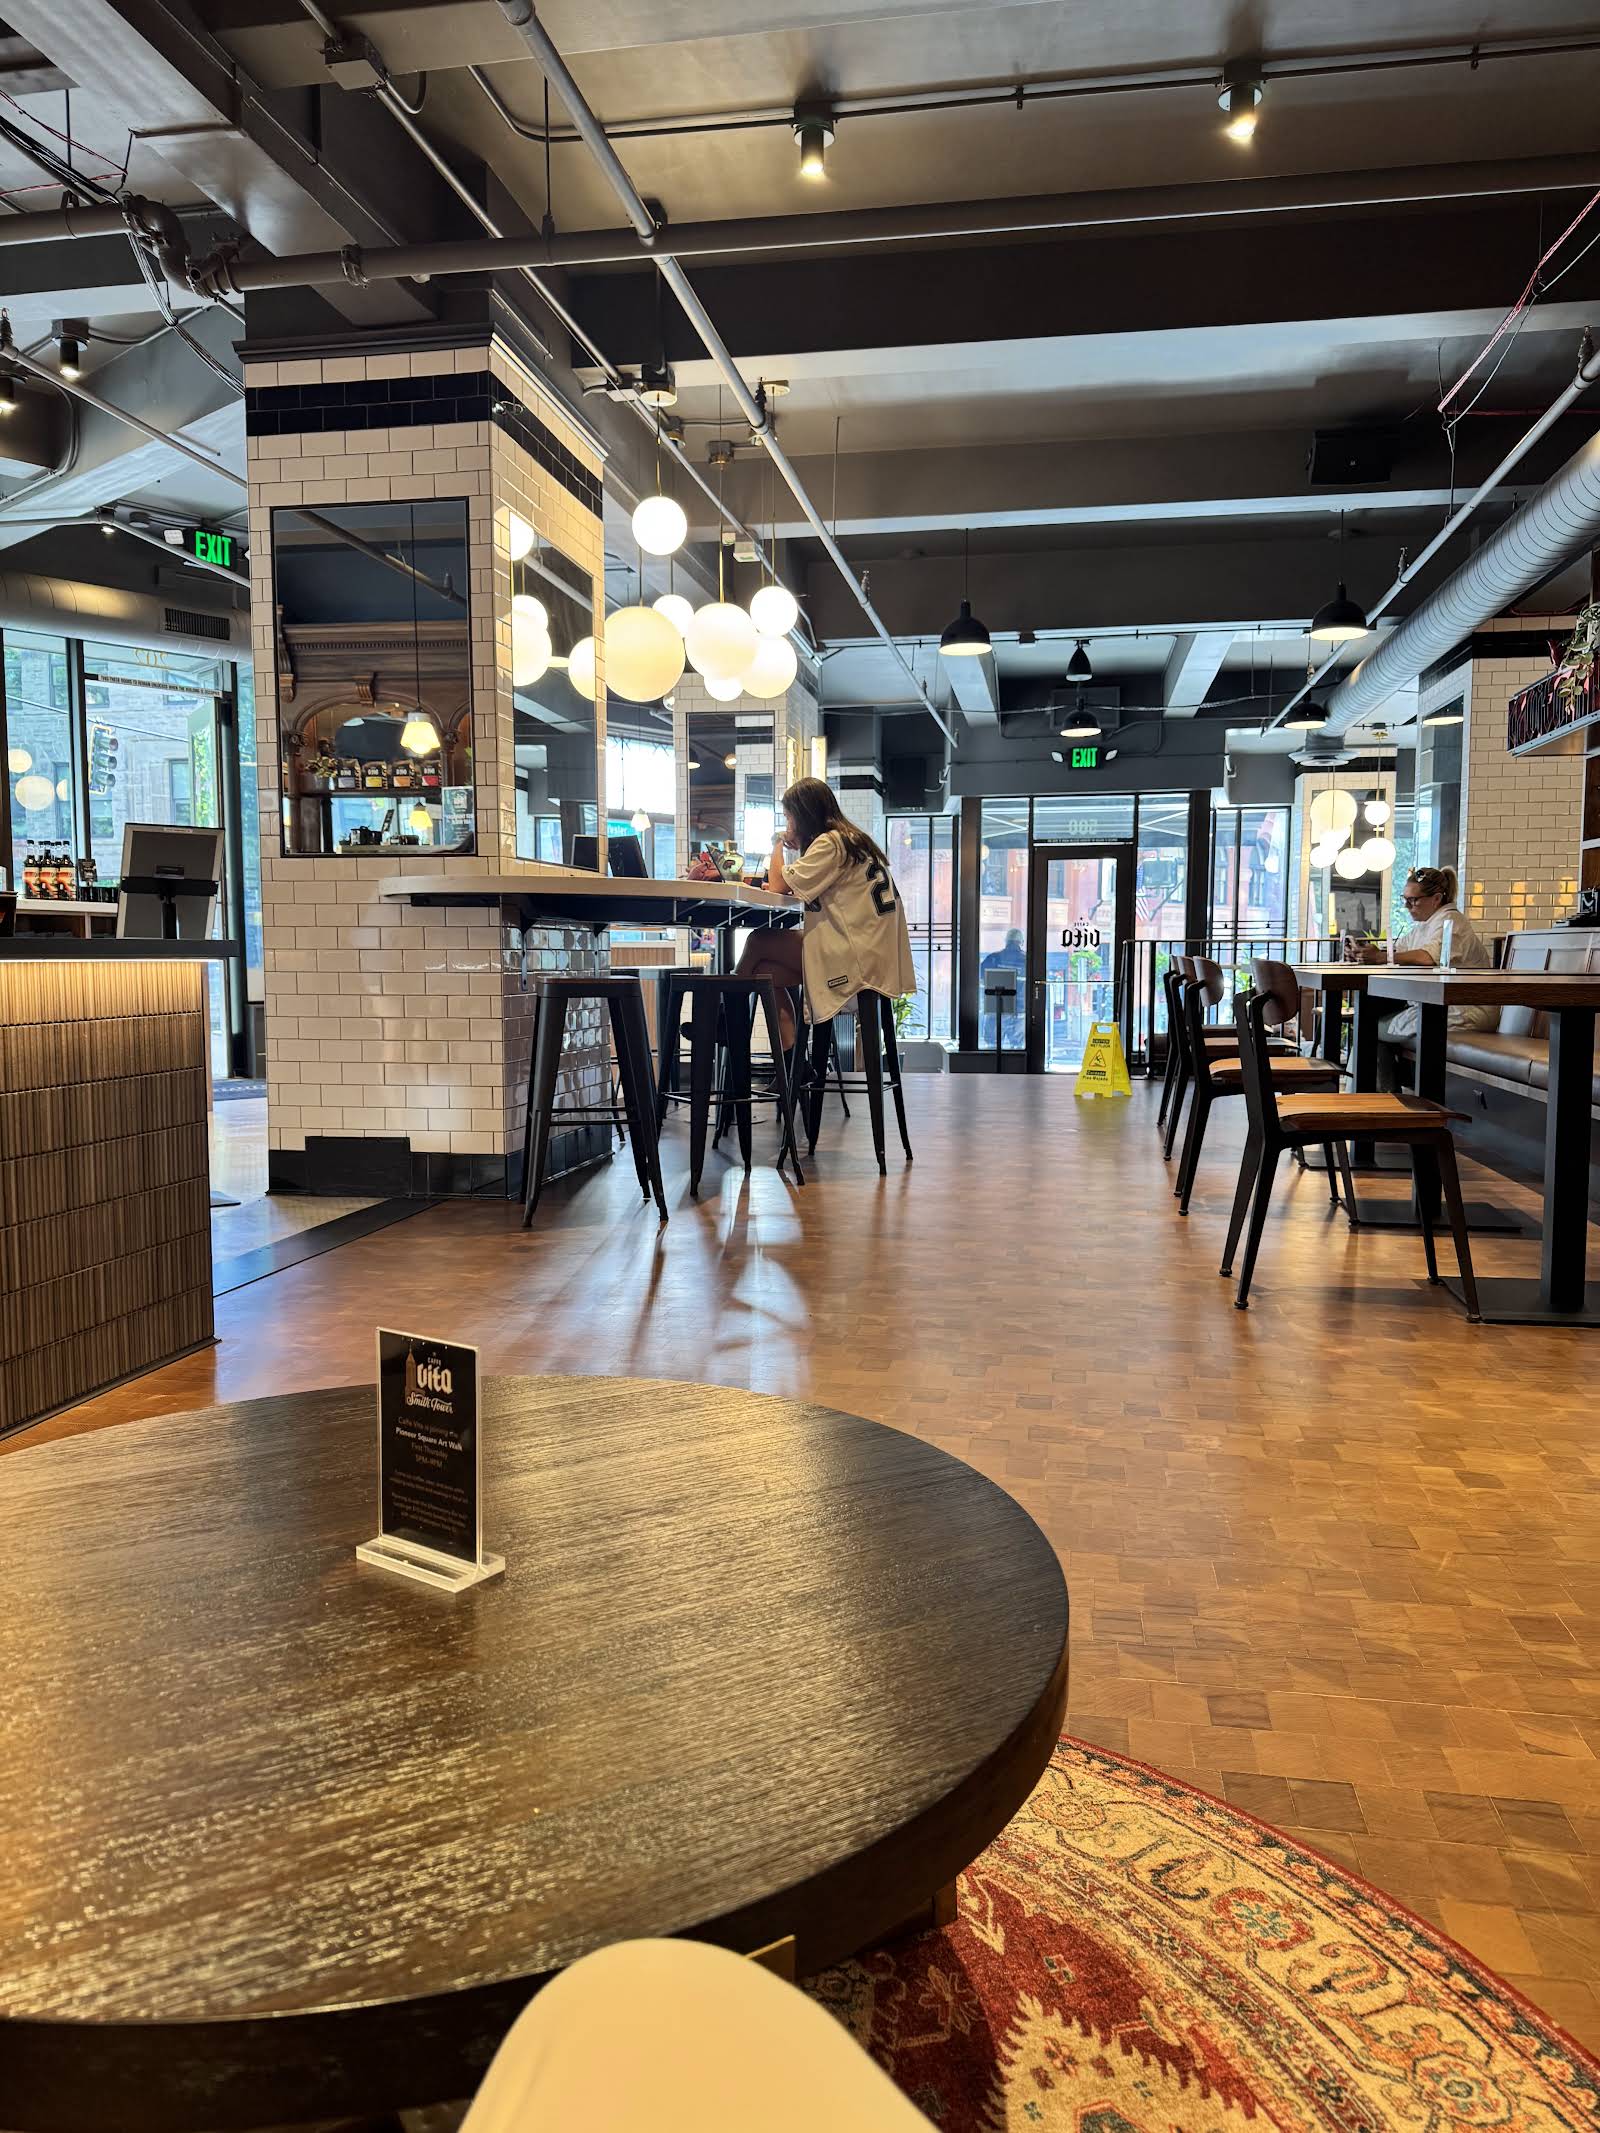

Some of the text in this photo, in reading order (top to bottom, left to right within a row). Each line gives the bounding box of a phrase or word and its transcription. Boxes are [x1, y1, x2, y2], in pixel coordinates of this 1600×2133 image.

[195, 530, 232, 567] EXIT
[1072, 747, 1098, 768] EXIT
[406, 1391, 454, 1414] Smith Tower
[395, 1426, 417, 1438] Pioneer
[417, 1432, 438, 1443] Square
[438, 1438, 448, 1448] Art
[448, 1441, 463, 1452] Walk
